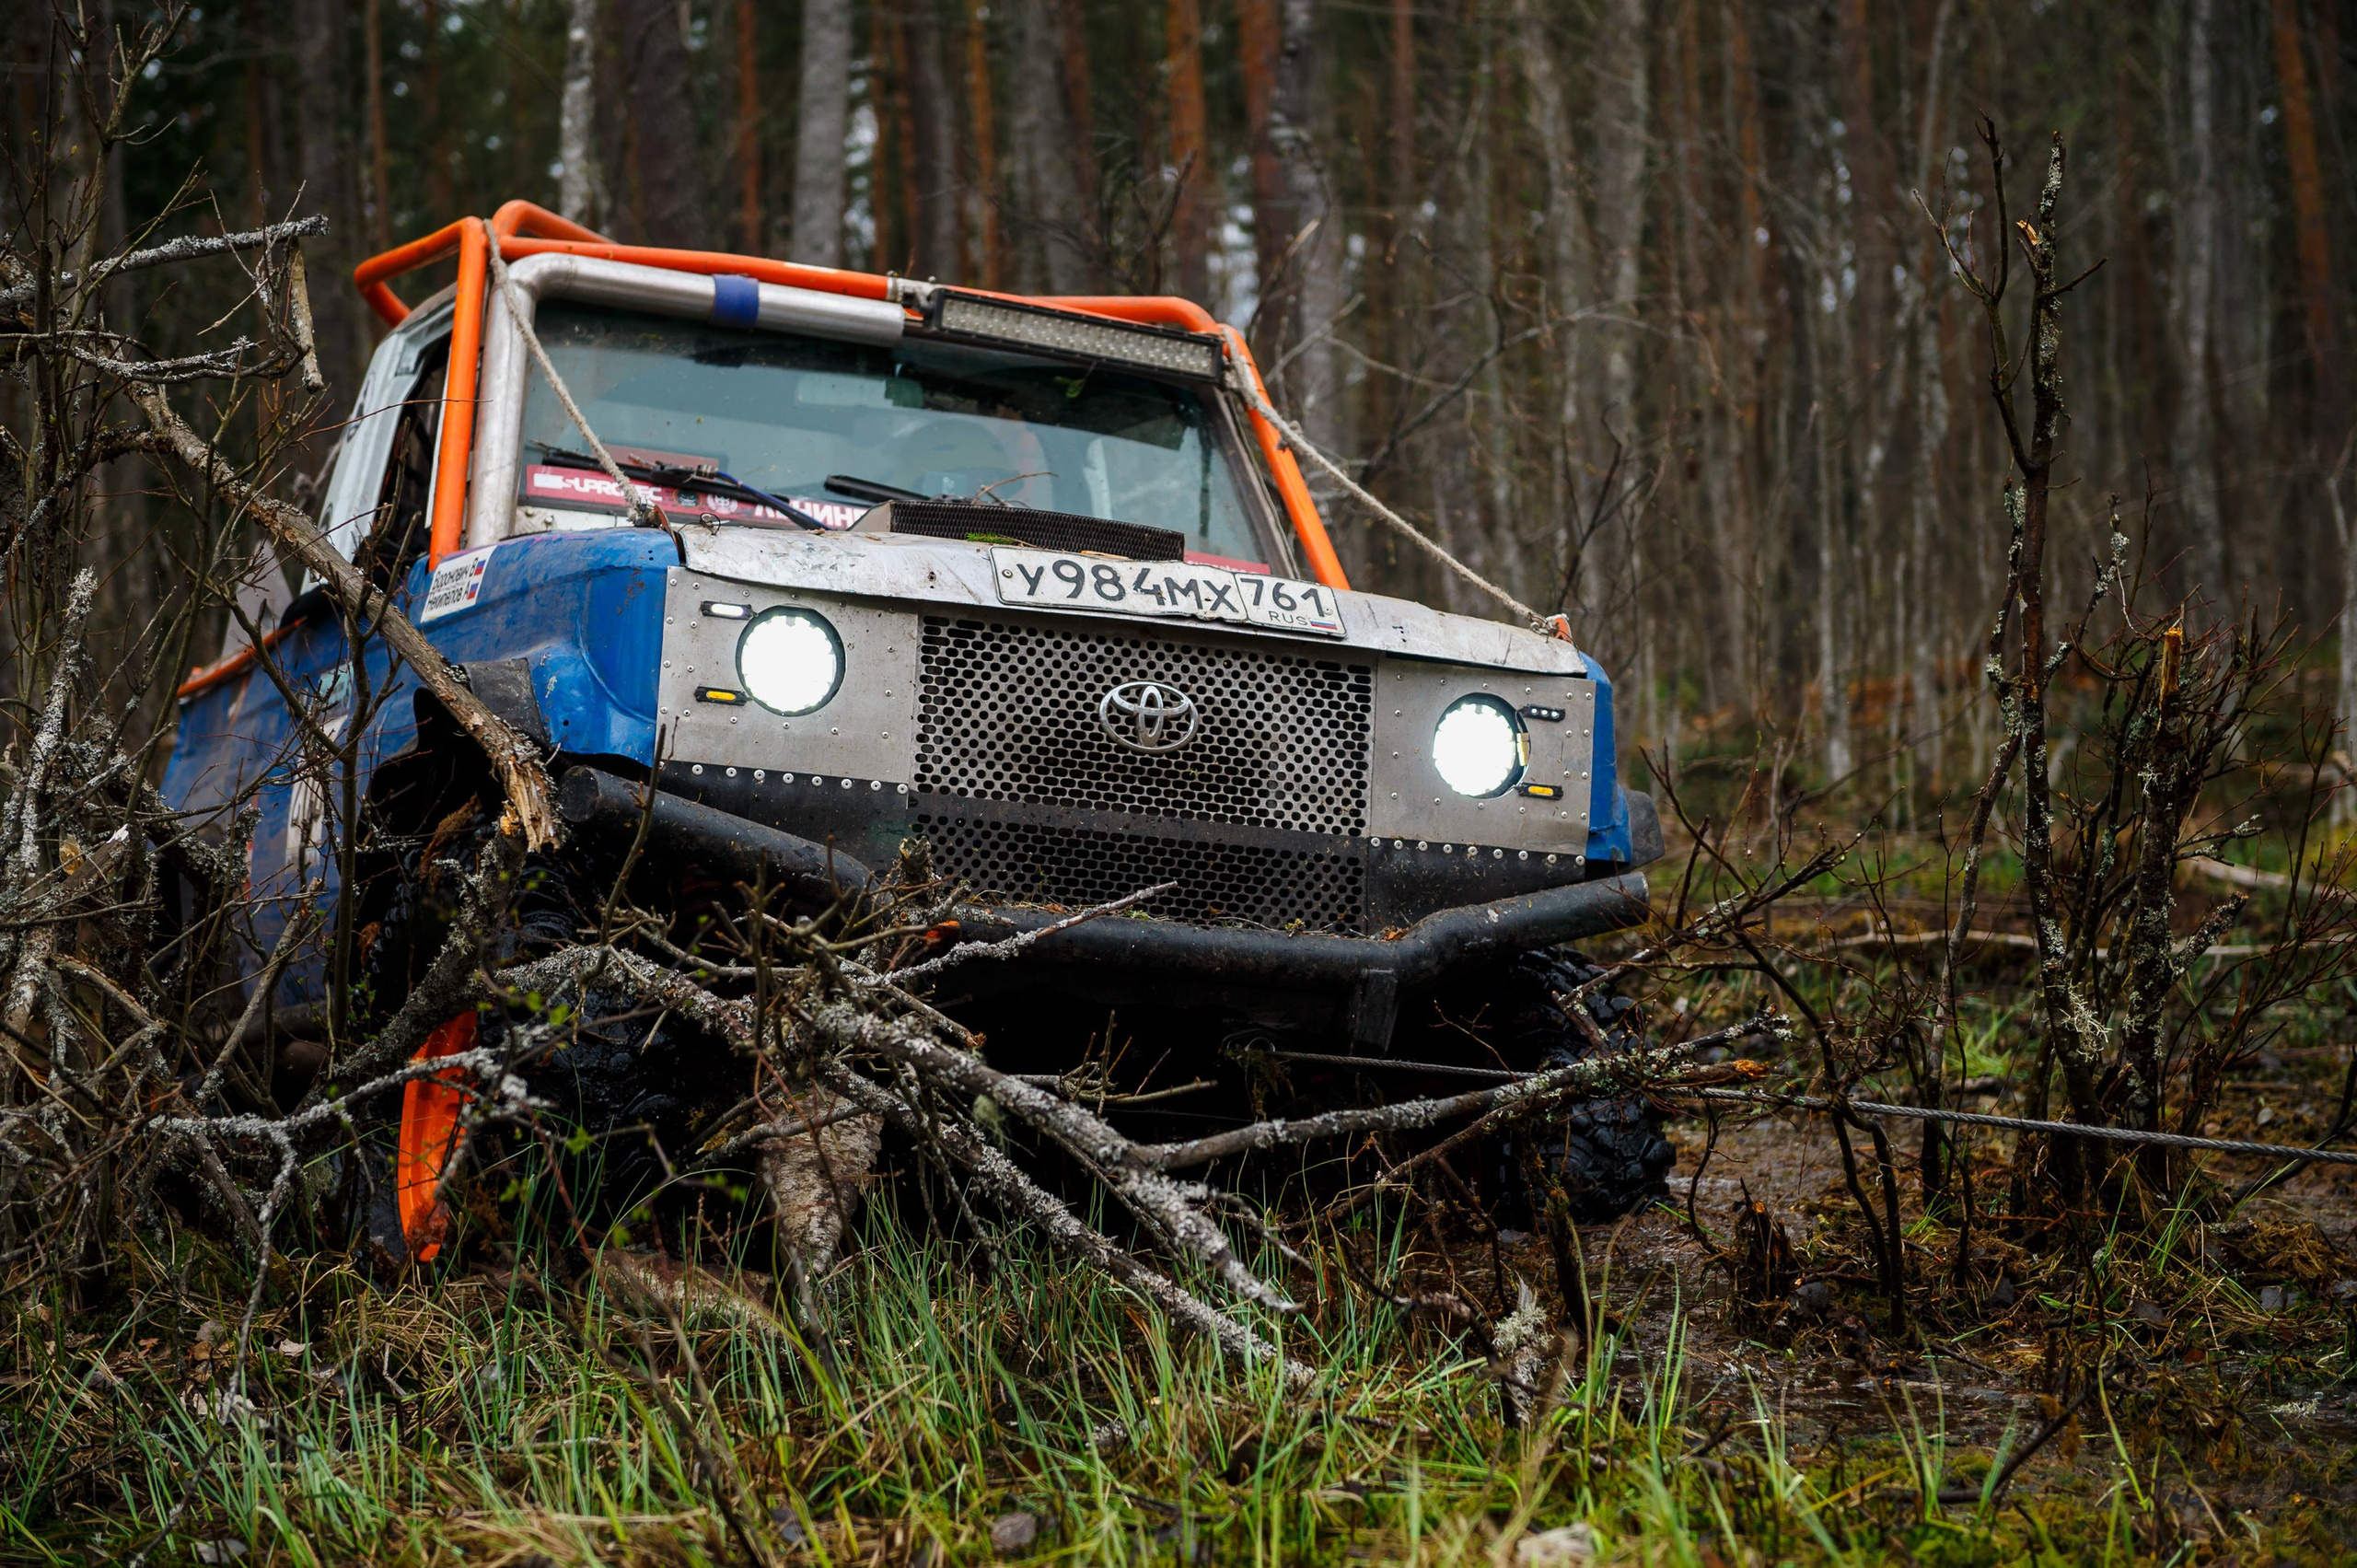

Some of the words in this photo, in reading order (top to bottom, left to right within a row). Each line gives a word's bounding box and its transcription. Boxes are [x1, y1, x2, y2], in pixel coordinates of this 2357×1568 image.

[561, 477, 663, 502] SUPROEC
[1239, 577, 1325, 618] 761
[1268, 610, 1308, 626] RUS
